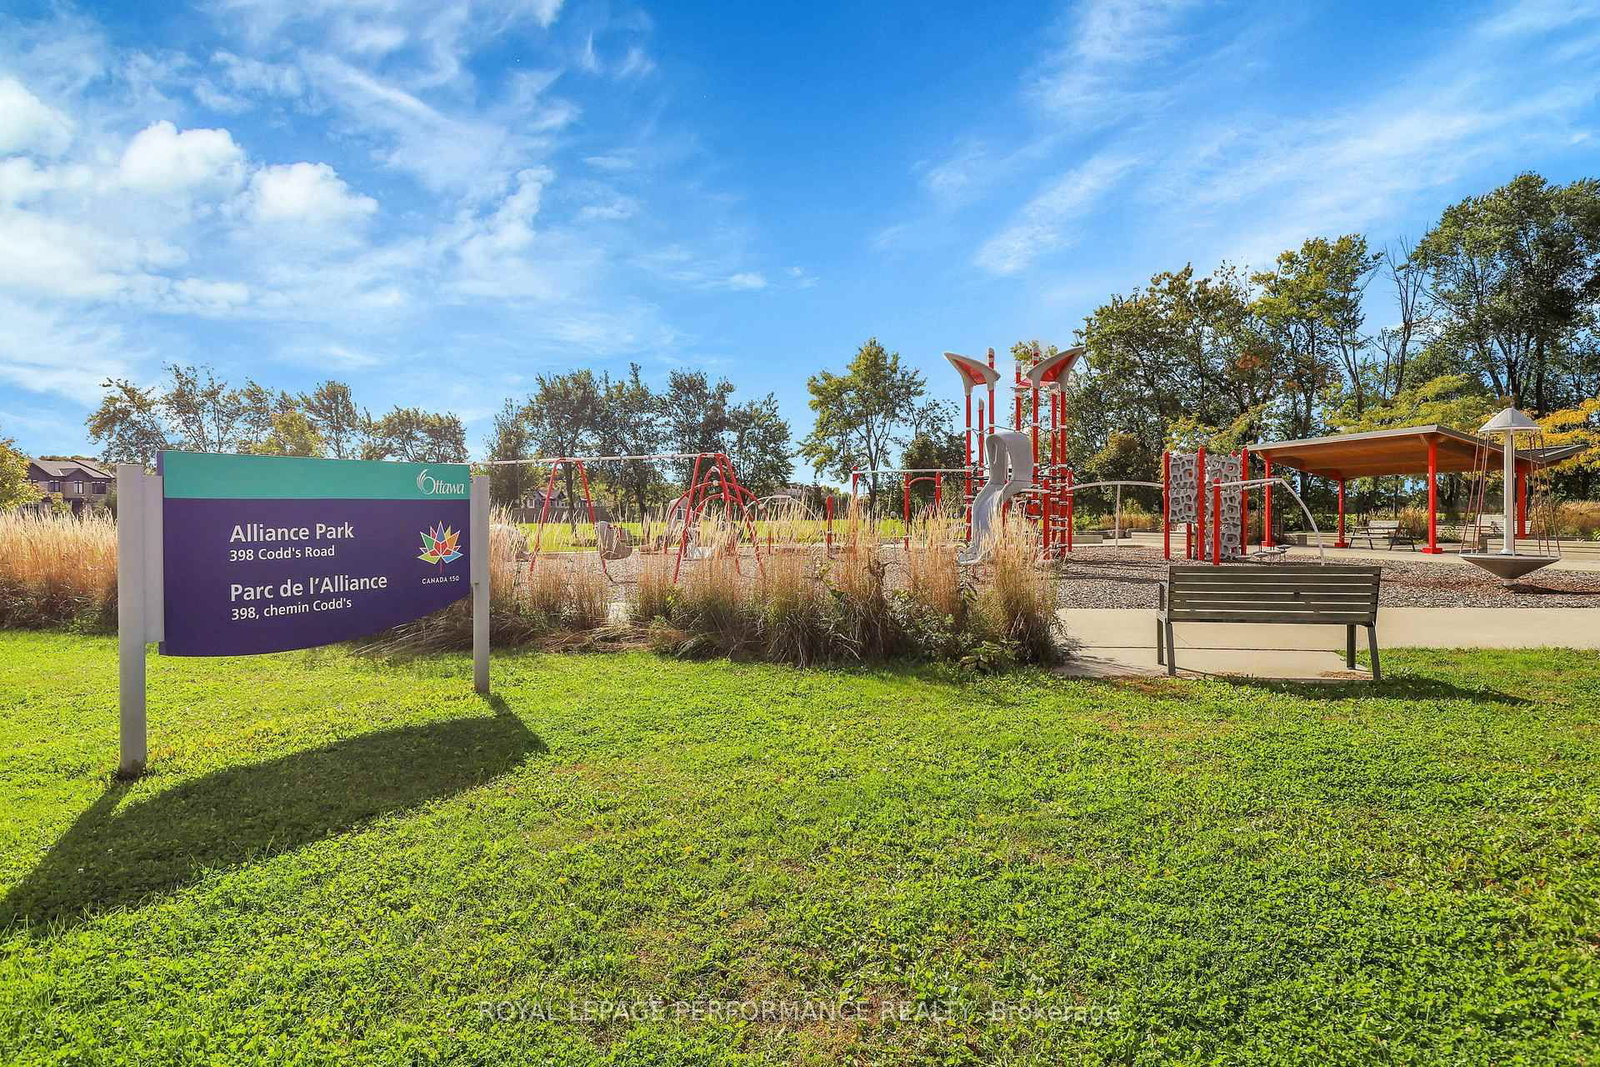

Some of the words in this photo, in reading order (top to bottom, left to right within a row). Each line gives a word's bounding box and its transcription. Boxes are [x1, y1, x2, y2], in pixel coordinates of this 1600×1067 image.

[417, 469, 465, 495] Ottawa
[229, 523, 310, 543] Alliance
[315, 522, 355, 540] Park
[229, 550, 254, 562] 398
[258, 547, 302, 560] Codd's
[305, 545, 336, 558] Road
[230, 583, 274, 602] Parc
[279, 579, 304, 597] de
[309, 574, 388, 595] l’Alliance
[421, 576, 448, 585] CANADA
[231, 606, 260, 621] 398,
[263, 602, 310, 617] chemin
[313, 597, 353, 612] Codd's
